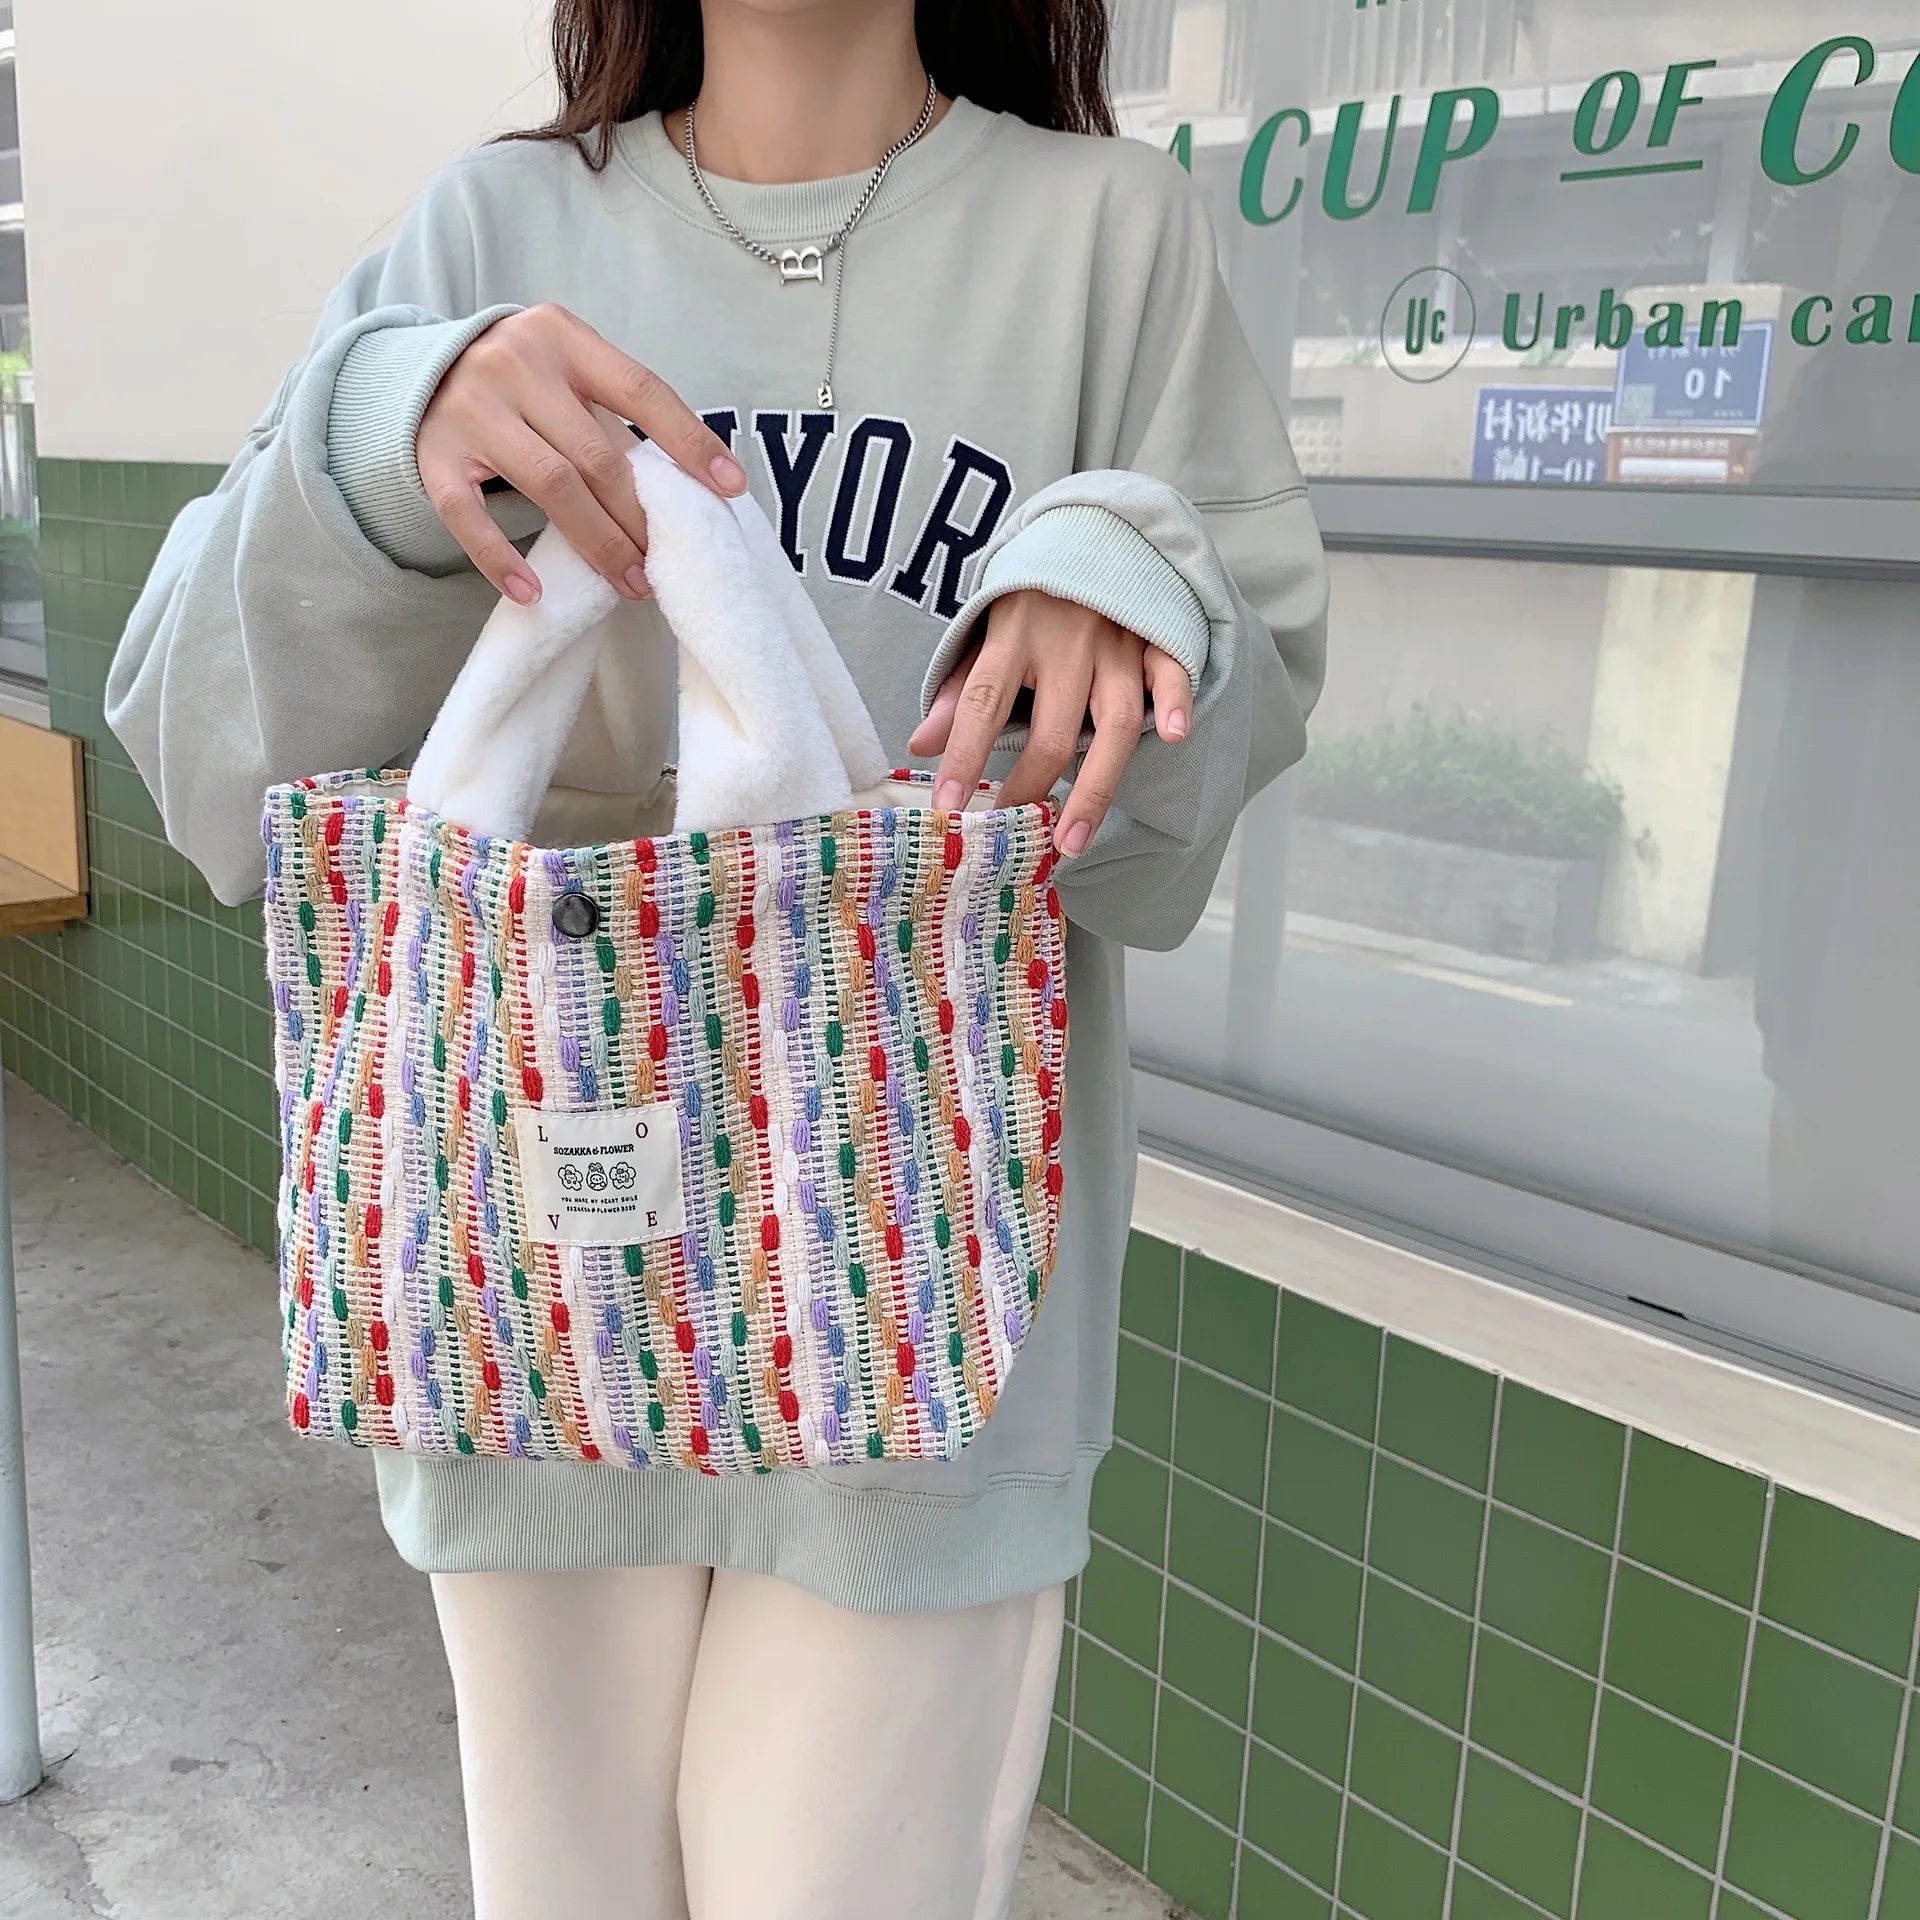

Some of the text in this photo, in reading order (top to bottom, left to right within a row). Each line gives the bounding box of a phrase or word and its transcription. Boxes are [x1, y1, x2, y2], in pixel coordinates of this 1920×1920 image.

[1239, 86, 1500, 227] CUP
[1572, 59, 1717, 157] OF
[1502, 289, 1743, 352] Urban
[537, 1122, 649, 1142] L O
[600, 1144, 635, 1155] FLOWER
[547, 1211, 658, 1230] V E
